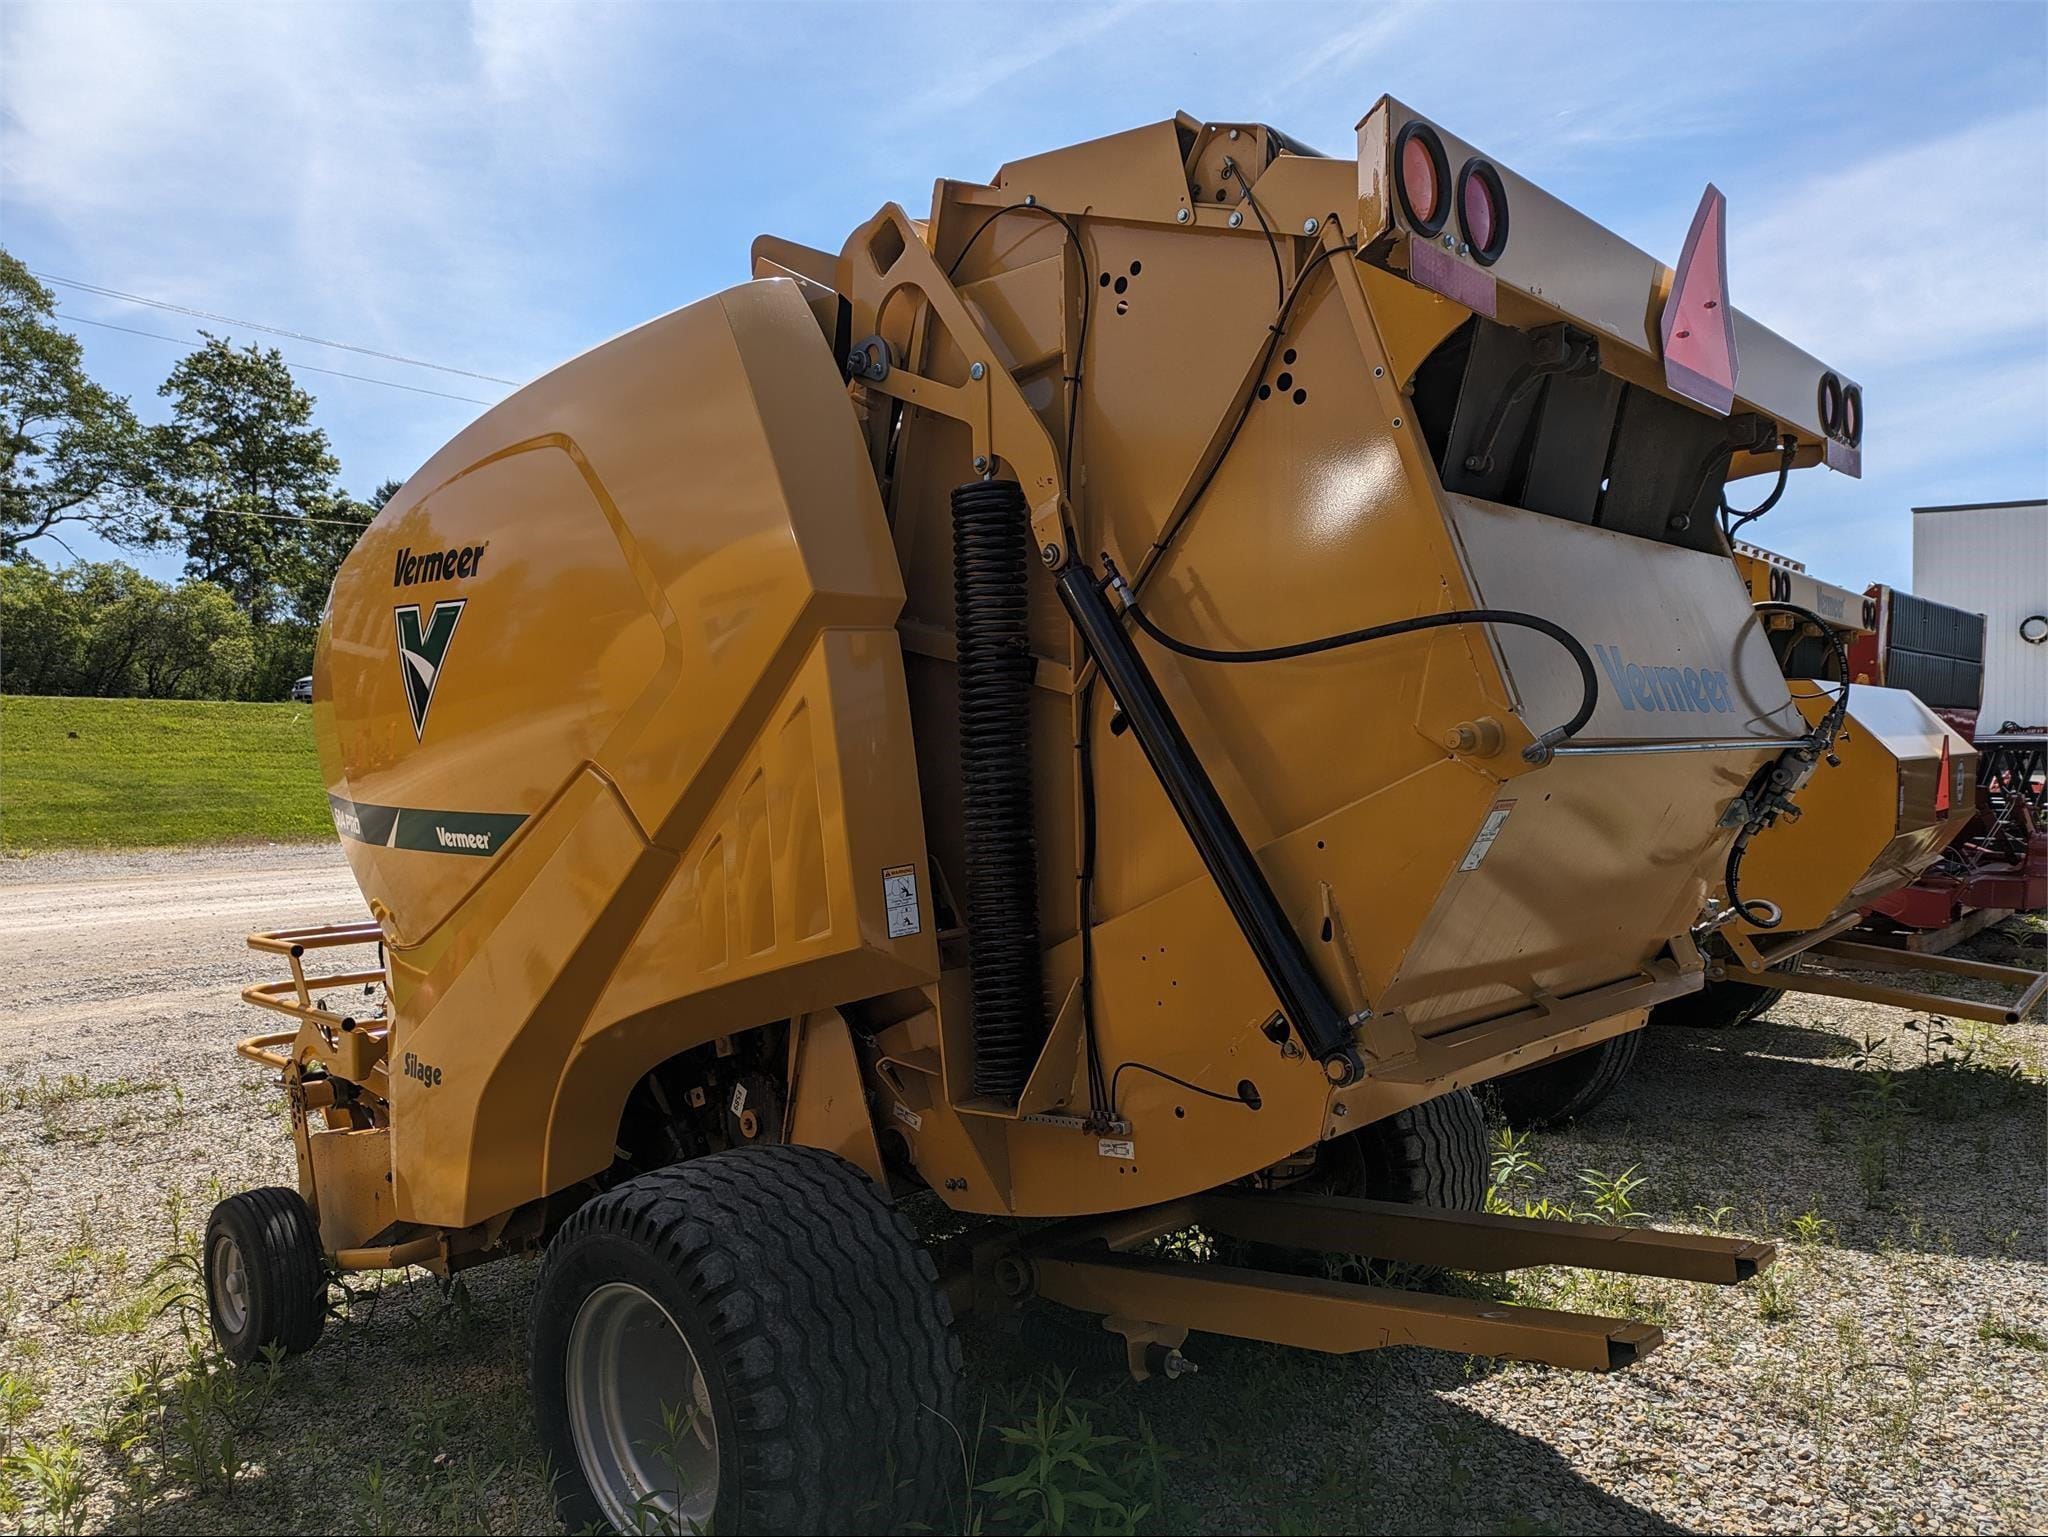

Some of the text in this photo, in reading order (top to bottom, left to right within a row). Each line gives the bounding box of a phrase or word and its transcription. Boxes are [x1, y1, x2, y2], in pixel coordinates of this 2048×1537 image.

[393, 545, 485, 587] Vermeer
[1593, 644, 1736, 713] Vermeer
[435, 826, 489, 850] Vermeer
[404, 1052, 442, 1088] Silage
